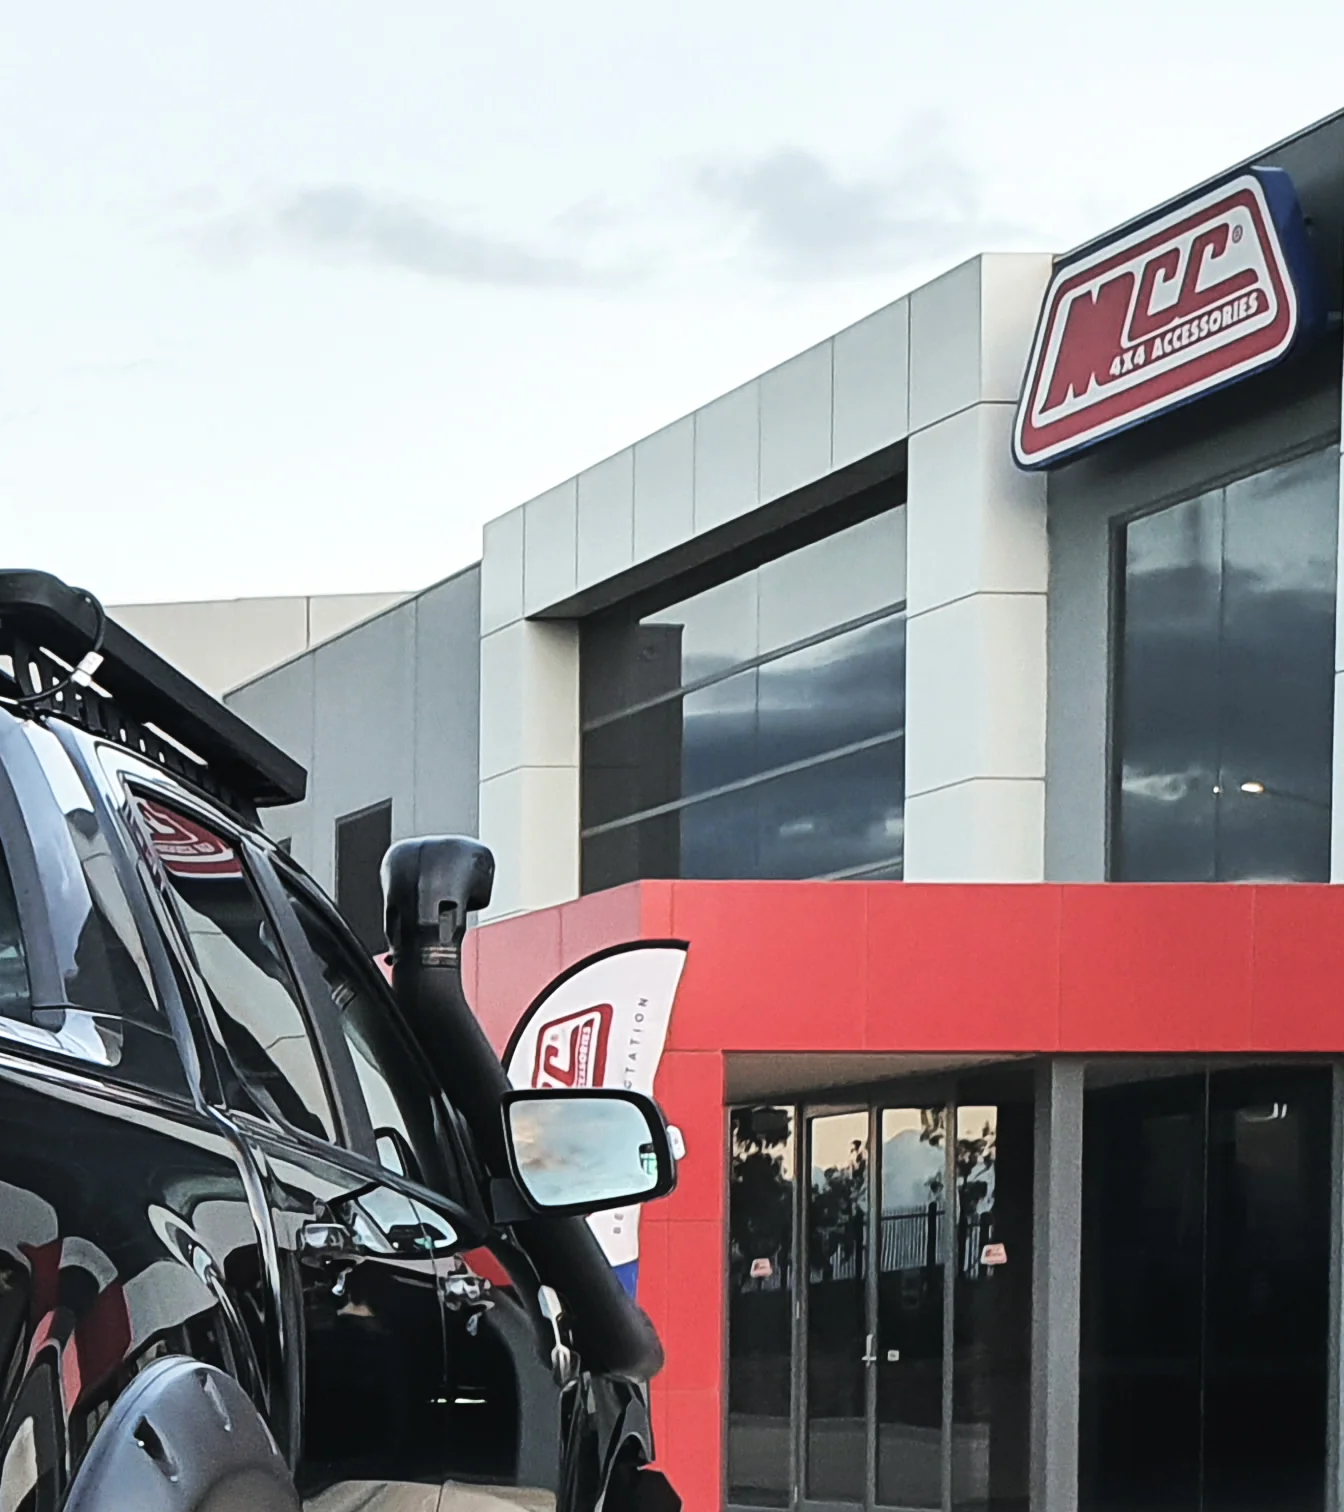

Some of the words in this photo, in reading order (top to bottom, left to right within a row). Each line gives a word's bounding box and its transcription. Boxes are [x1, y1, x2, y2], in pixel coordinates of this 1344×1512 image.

[1038, 222, 1259, 415] MCC
[1109, 344, 1146, 375] 4X4
[1151, 292, 1258, 360] ACCESSORIES
[624, 997, 649, 1090] CTATION
